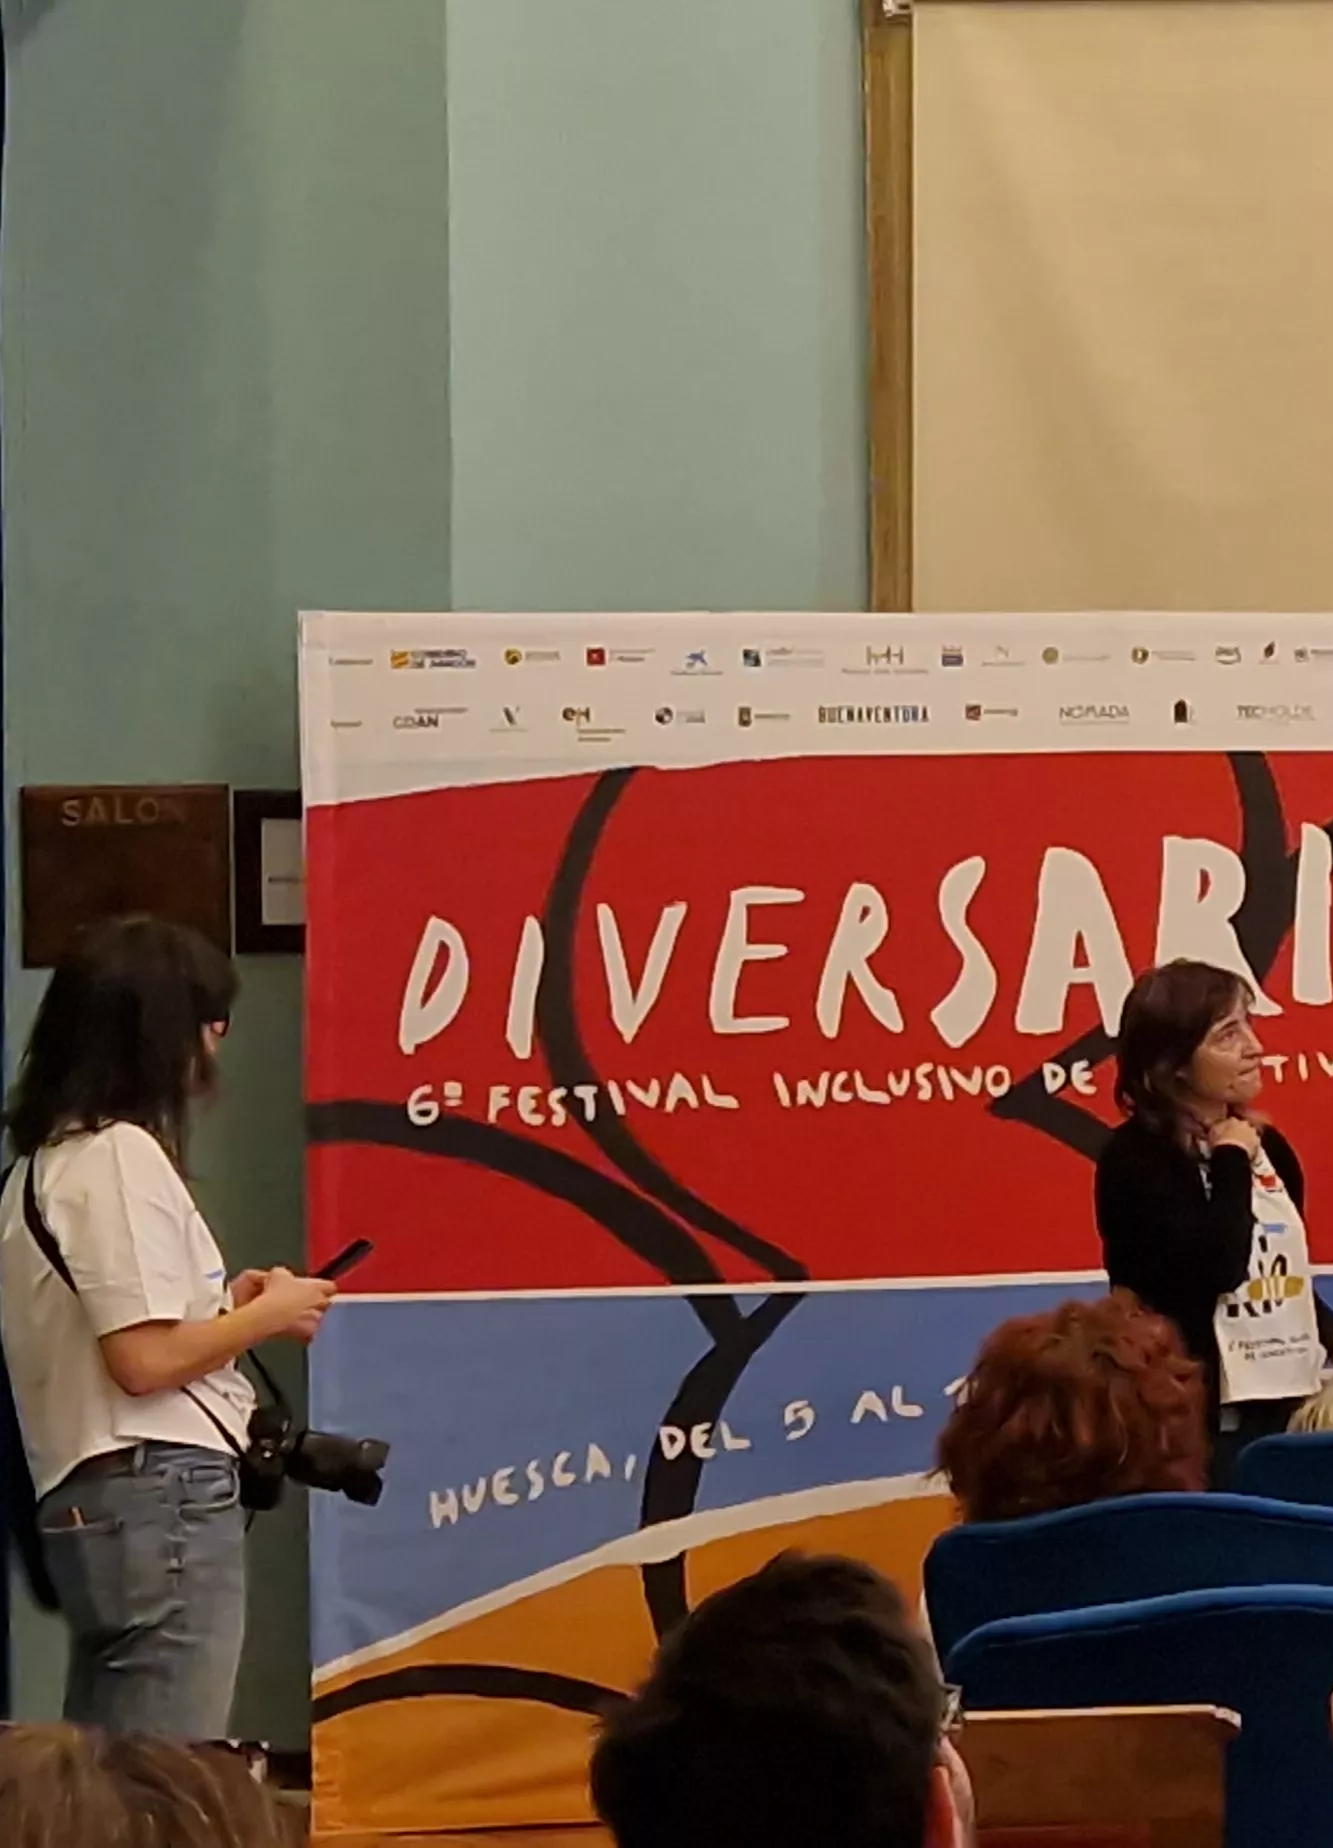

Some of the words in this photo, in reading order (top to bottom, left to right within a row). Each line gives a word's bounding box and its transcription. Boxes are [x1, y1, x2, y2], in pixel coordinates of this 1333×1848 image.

[818, 704, 929, 724] BUENAVENTURA
[407, 1080, 464, 1126] 6º
[487, 1072, 740, 1127] FESTIVAL
[773, 1062, 1012, 1108] INCLUSIVO
[1042, 1060, 1097, 1095] DE
[429, 1442, 636, 1529] HUESCA,
[659, 1419, 752, 1461] DEL
[783, 1399, 816, 1441] 5
[850, 1384, 925, 1424] AL
